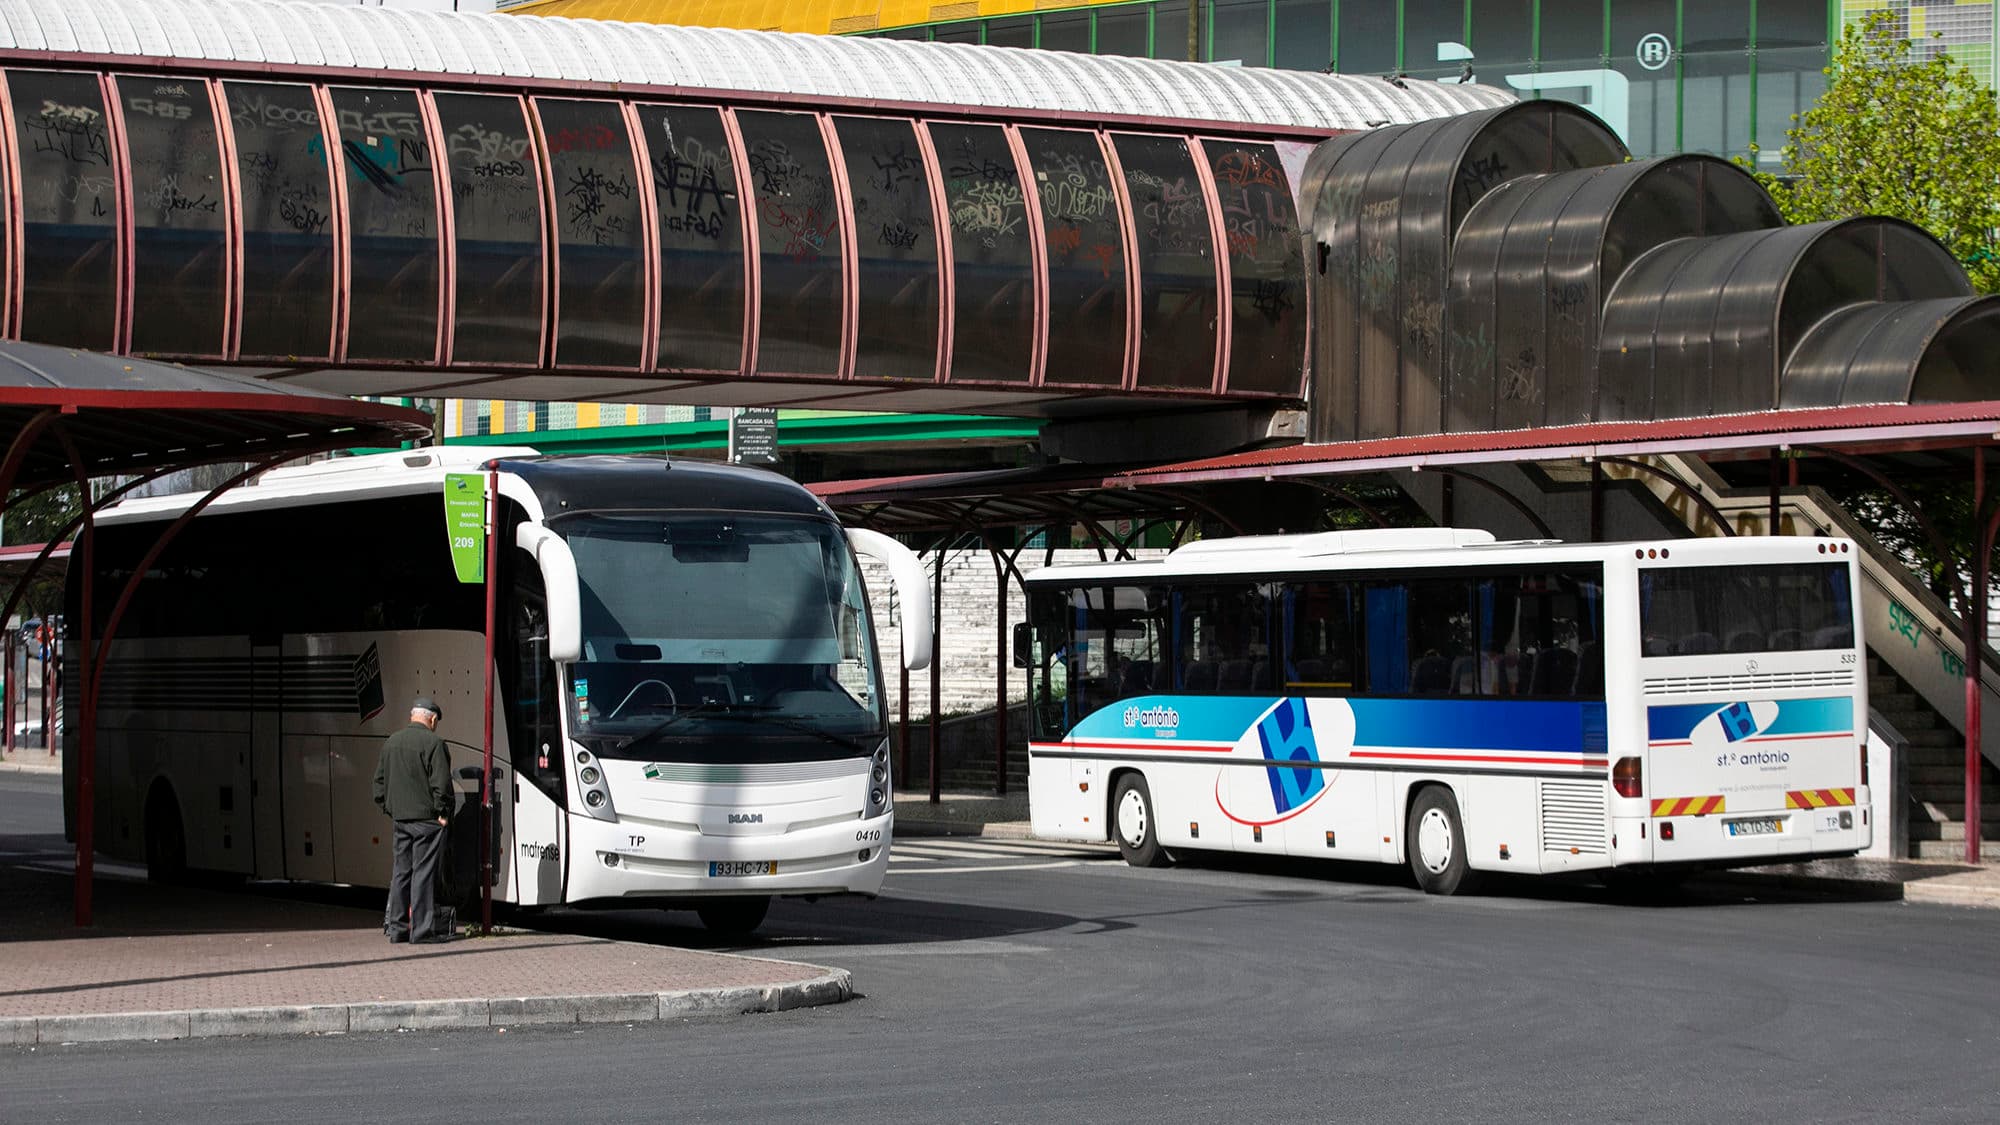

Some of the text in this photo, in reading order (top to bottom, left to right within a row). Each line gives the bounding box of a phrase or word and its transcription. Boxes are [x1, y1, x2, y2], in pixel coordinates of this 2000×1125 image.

[455, 537, 474, 548] 209
[1841, 654, 1856, 664] 533
[1141, 705, 1180, 728] antónio
[1740, 749, 1790, 765] antónio
[728, 814, 763, 824] MAN
[1827, 816, 1838, 828] TP
[855, 830, 881, 841] 0410
[629, 836, 646, 847] TP
[521, 841, 560, 862] mafrense
